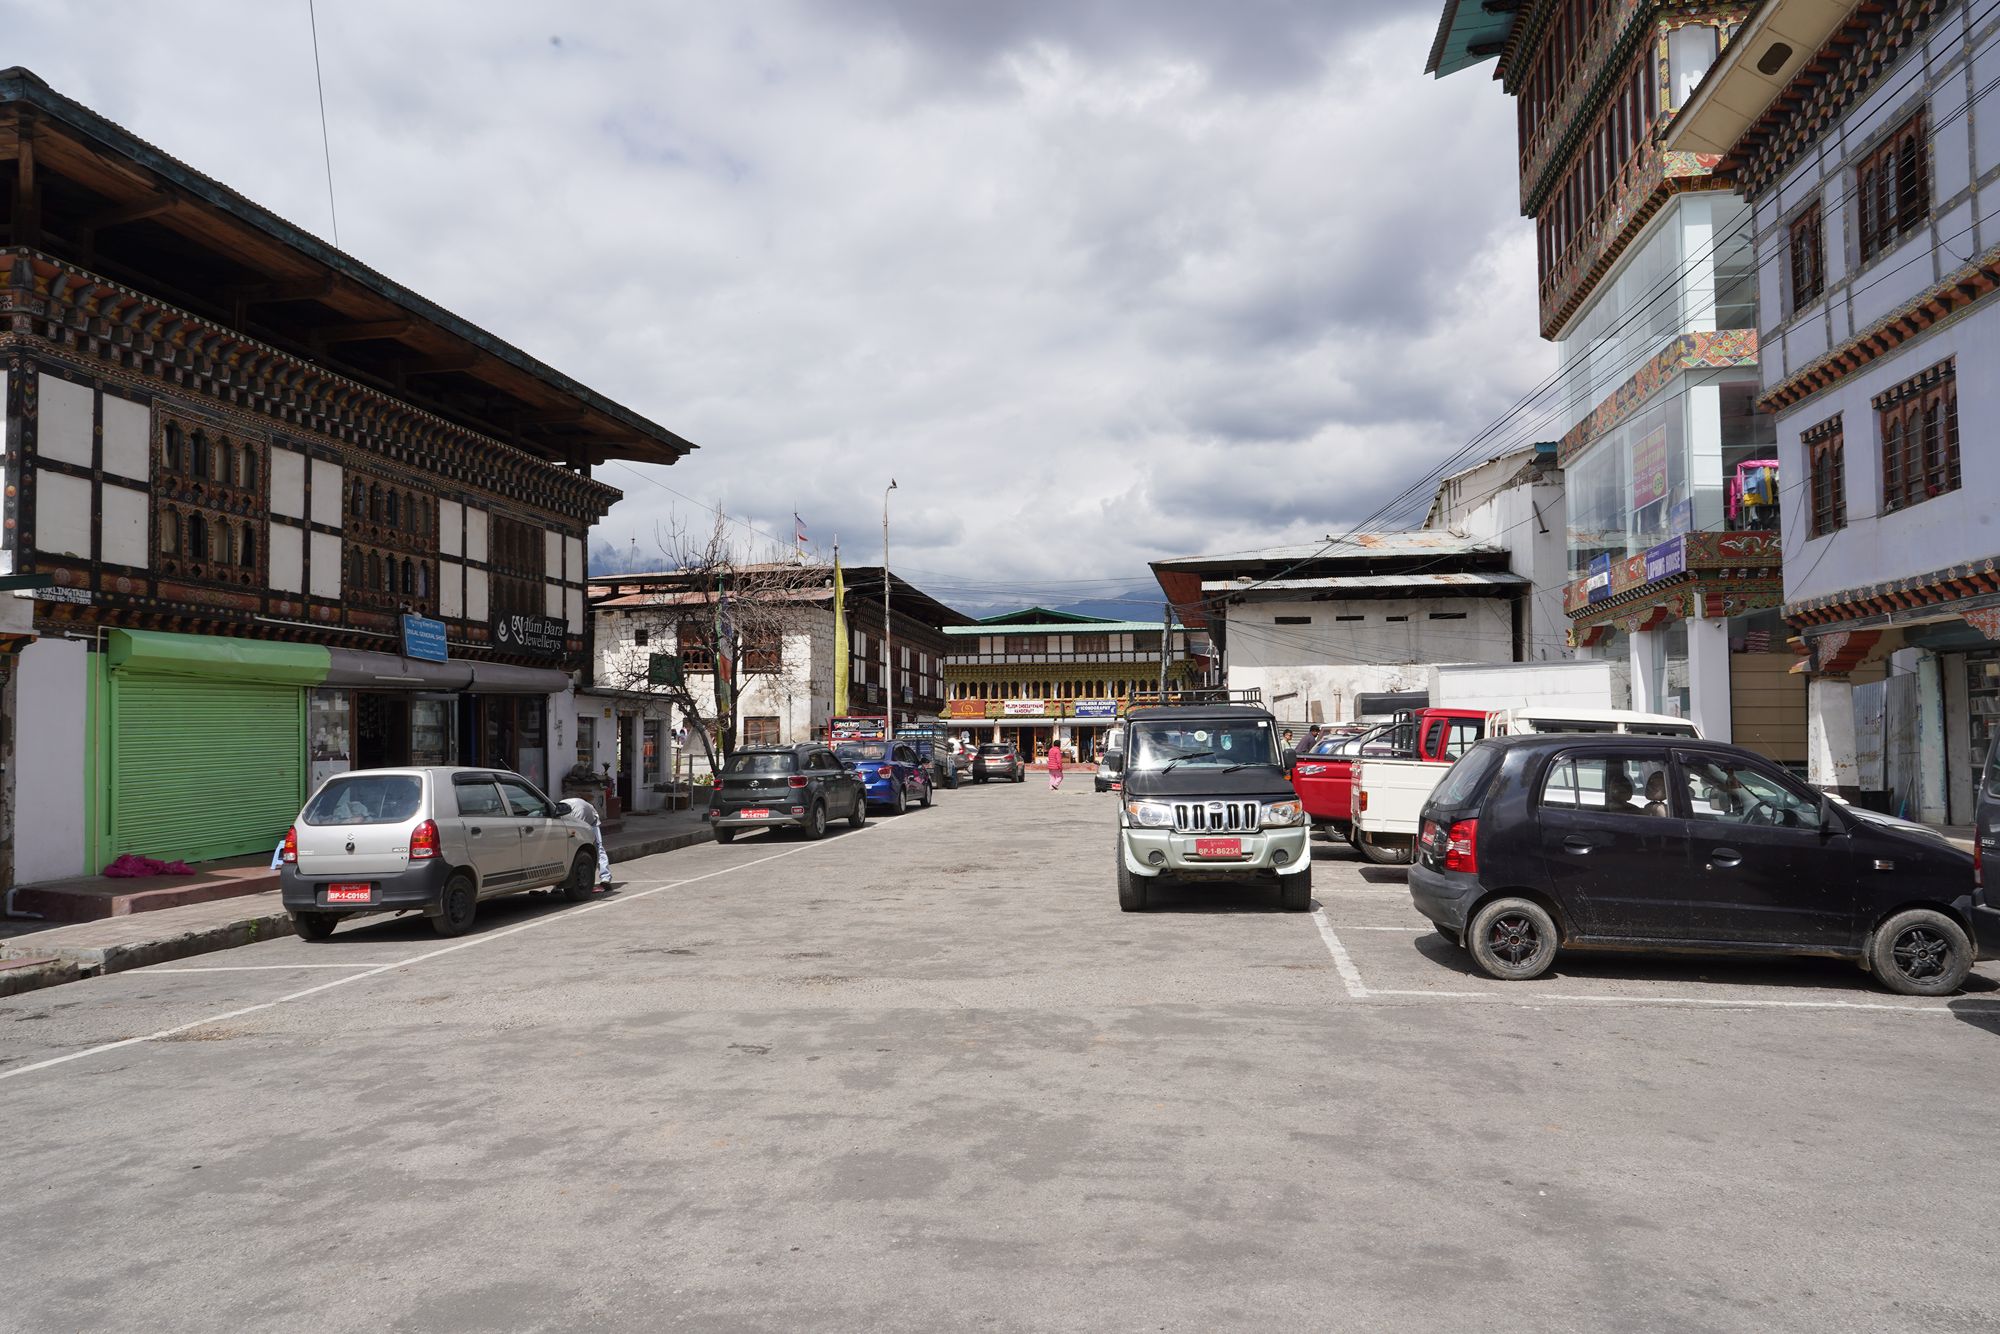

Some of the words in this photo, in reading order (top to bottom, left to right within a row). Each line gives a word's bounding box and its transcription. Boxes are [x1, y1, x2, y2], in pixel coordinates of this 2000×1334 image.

[543, 620, 563, 636] Bara
[524, 632, 561, 652] Jewellerys
[1198, 847, 1239, 855] BP-1-B6234
